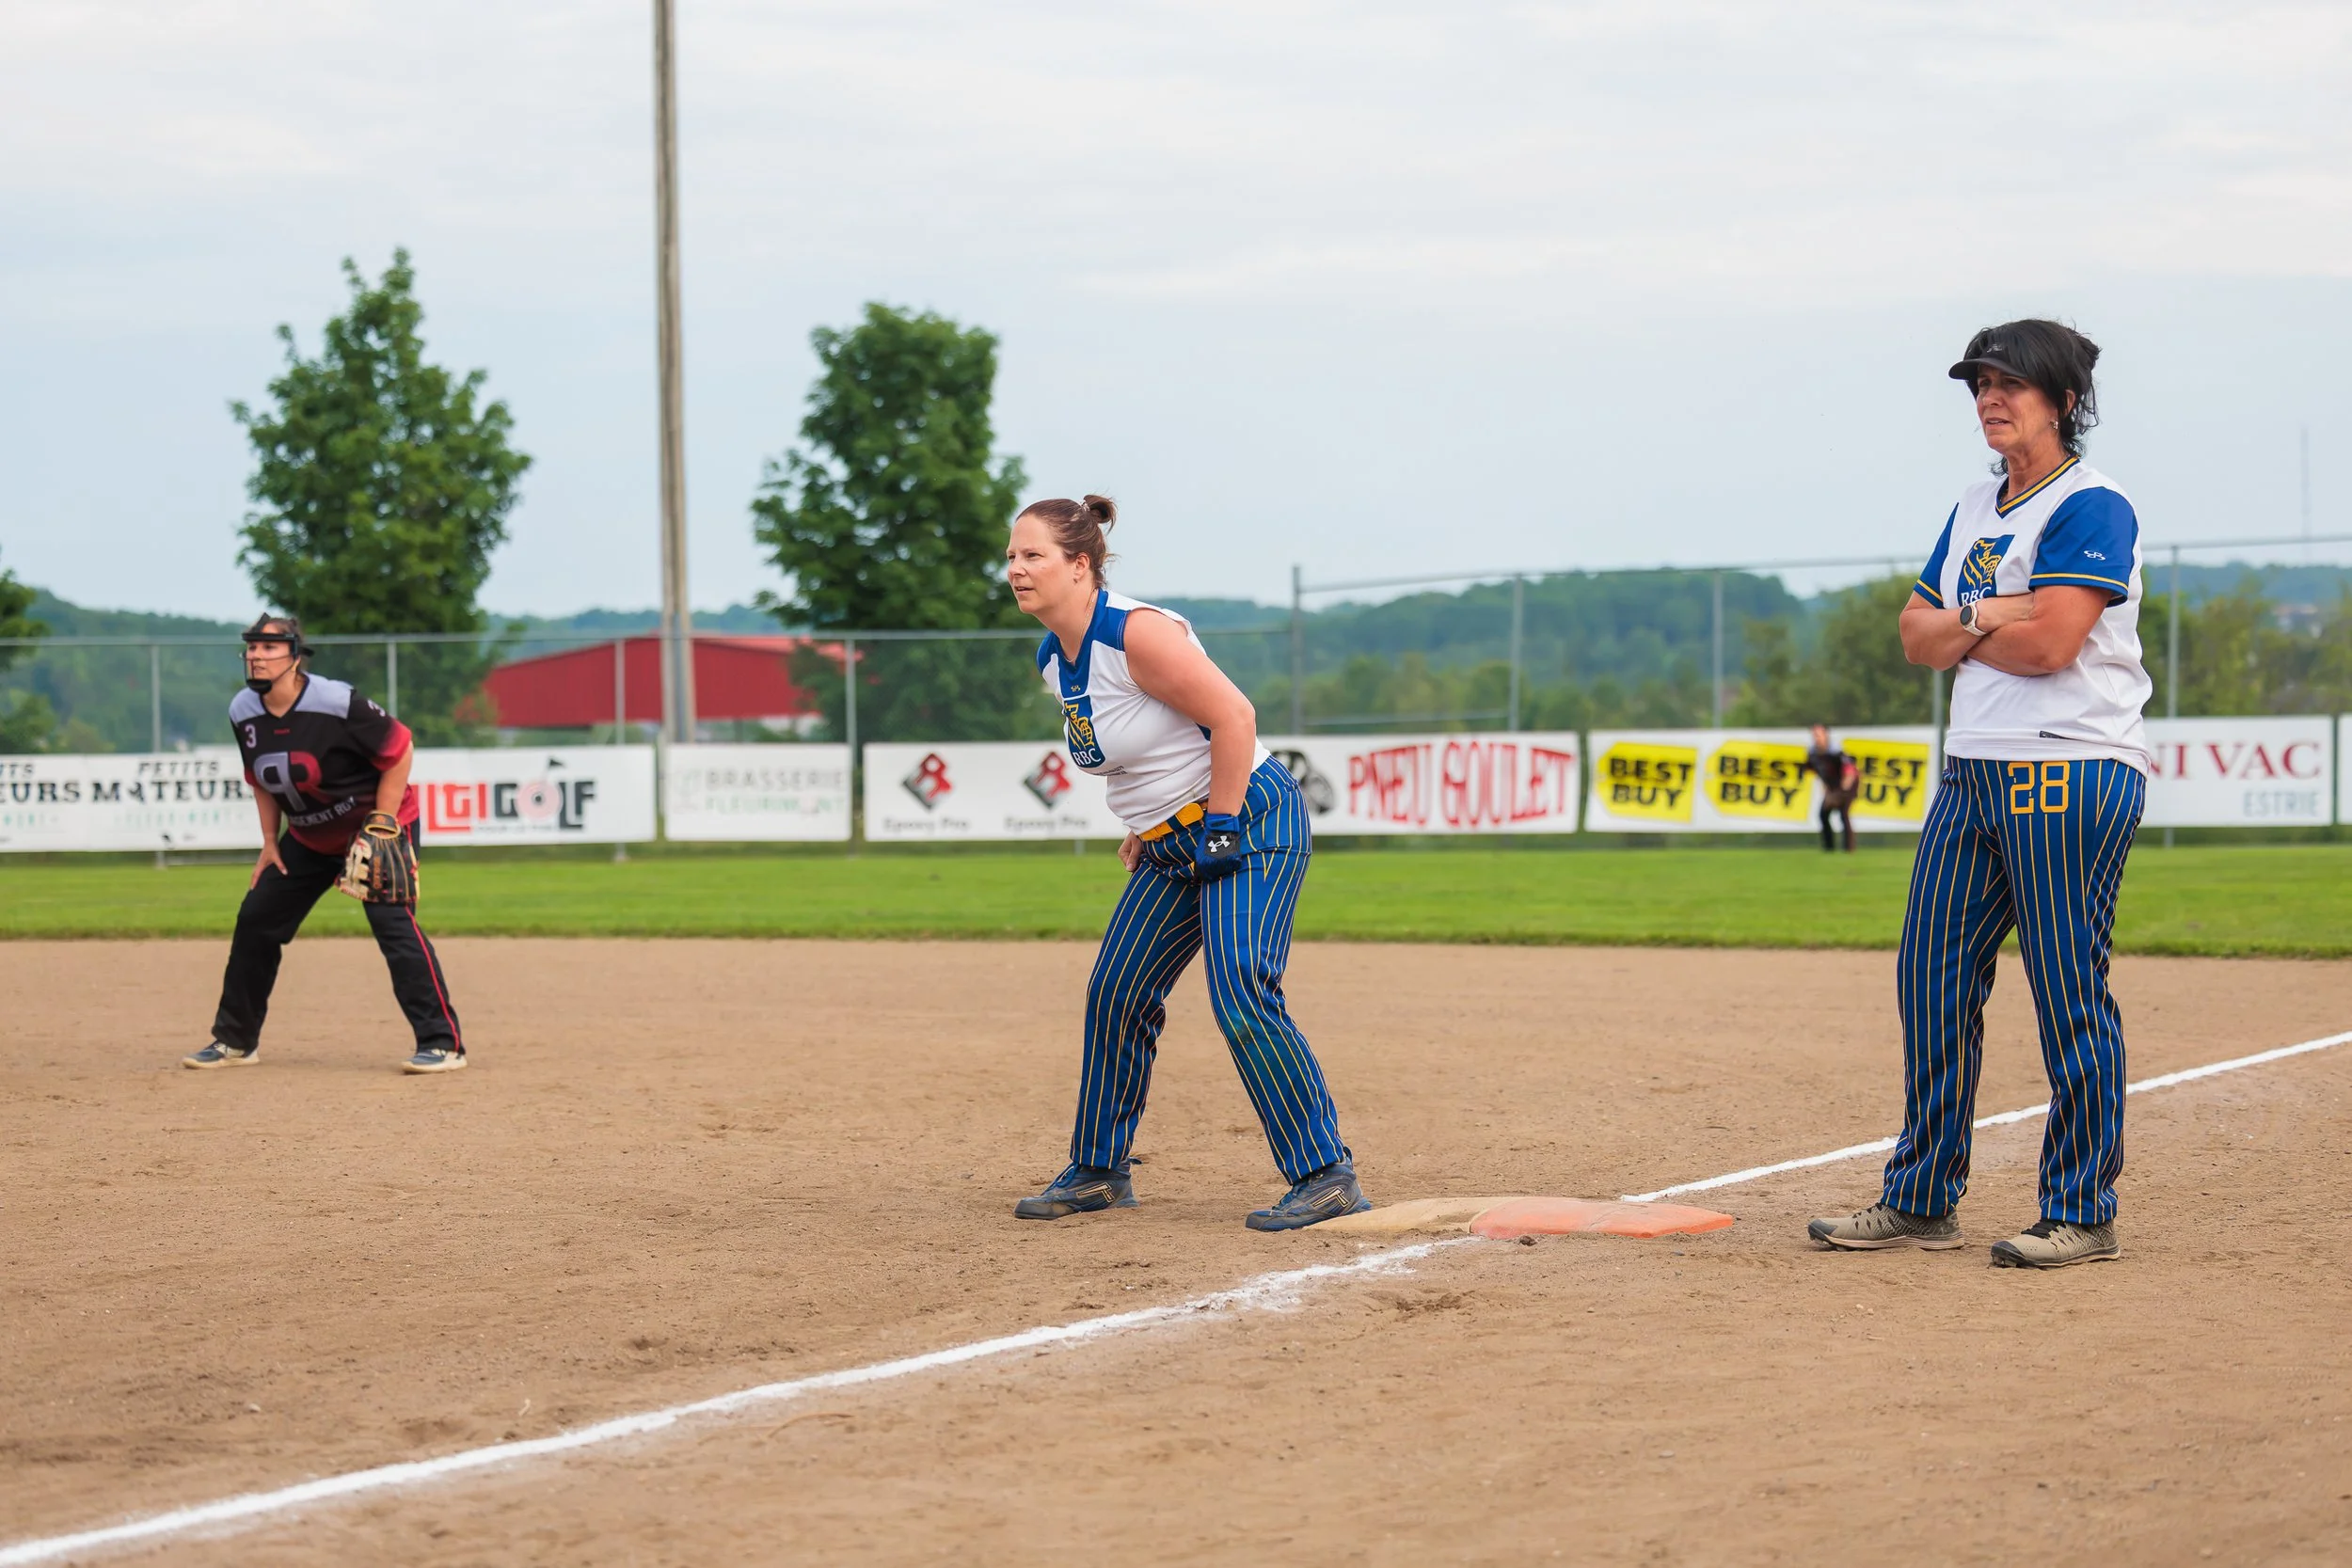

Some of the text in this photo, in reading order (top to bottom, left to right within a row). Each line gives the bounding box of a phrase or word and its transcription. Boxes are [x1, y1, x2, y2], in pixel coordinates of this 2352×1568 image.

[1961, 586, 1992, 607] RBC
[245, 723, 258, 749] 3
[1073, 748, 1102, 766] RBC
[1610, 756, 1692, 784] BEST
[1719, 755, 1806, 783] BEST
[1849, 755, 1924, 780] EST
[2204, 740, 2321, 780] VAC
[706, 768, 846, 792] BRASSERIE
[1348, 739, 1573, 828] PNEU GOULET
[2008, 761, 2070, 815] 28
[1612, 784, 1683, 809] BUY
[1721, 782, 1801, 809] BUY
[1857, 783, 1914, 806] UY
[2243, 790, 2320, 817] ESTRIE
